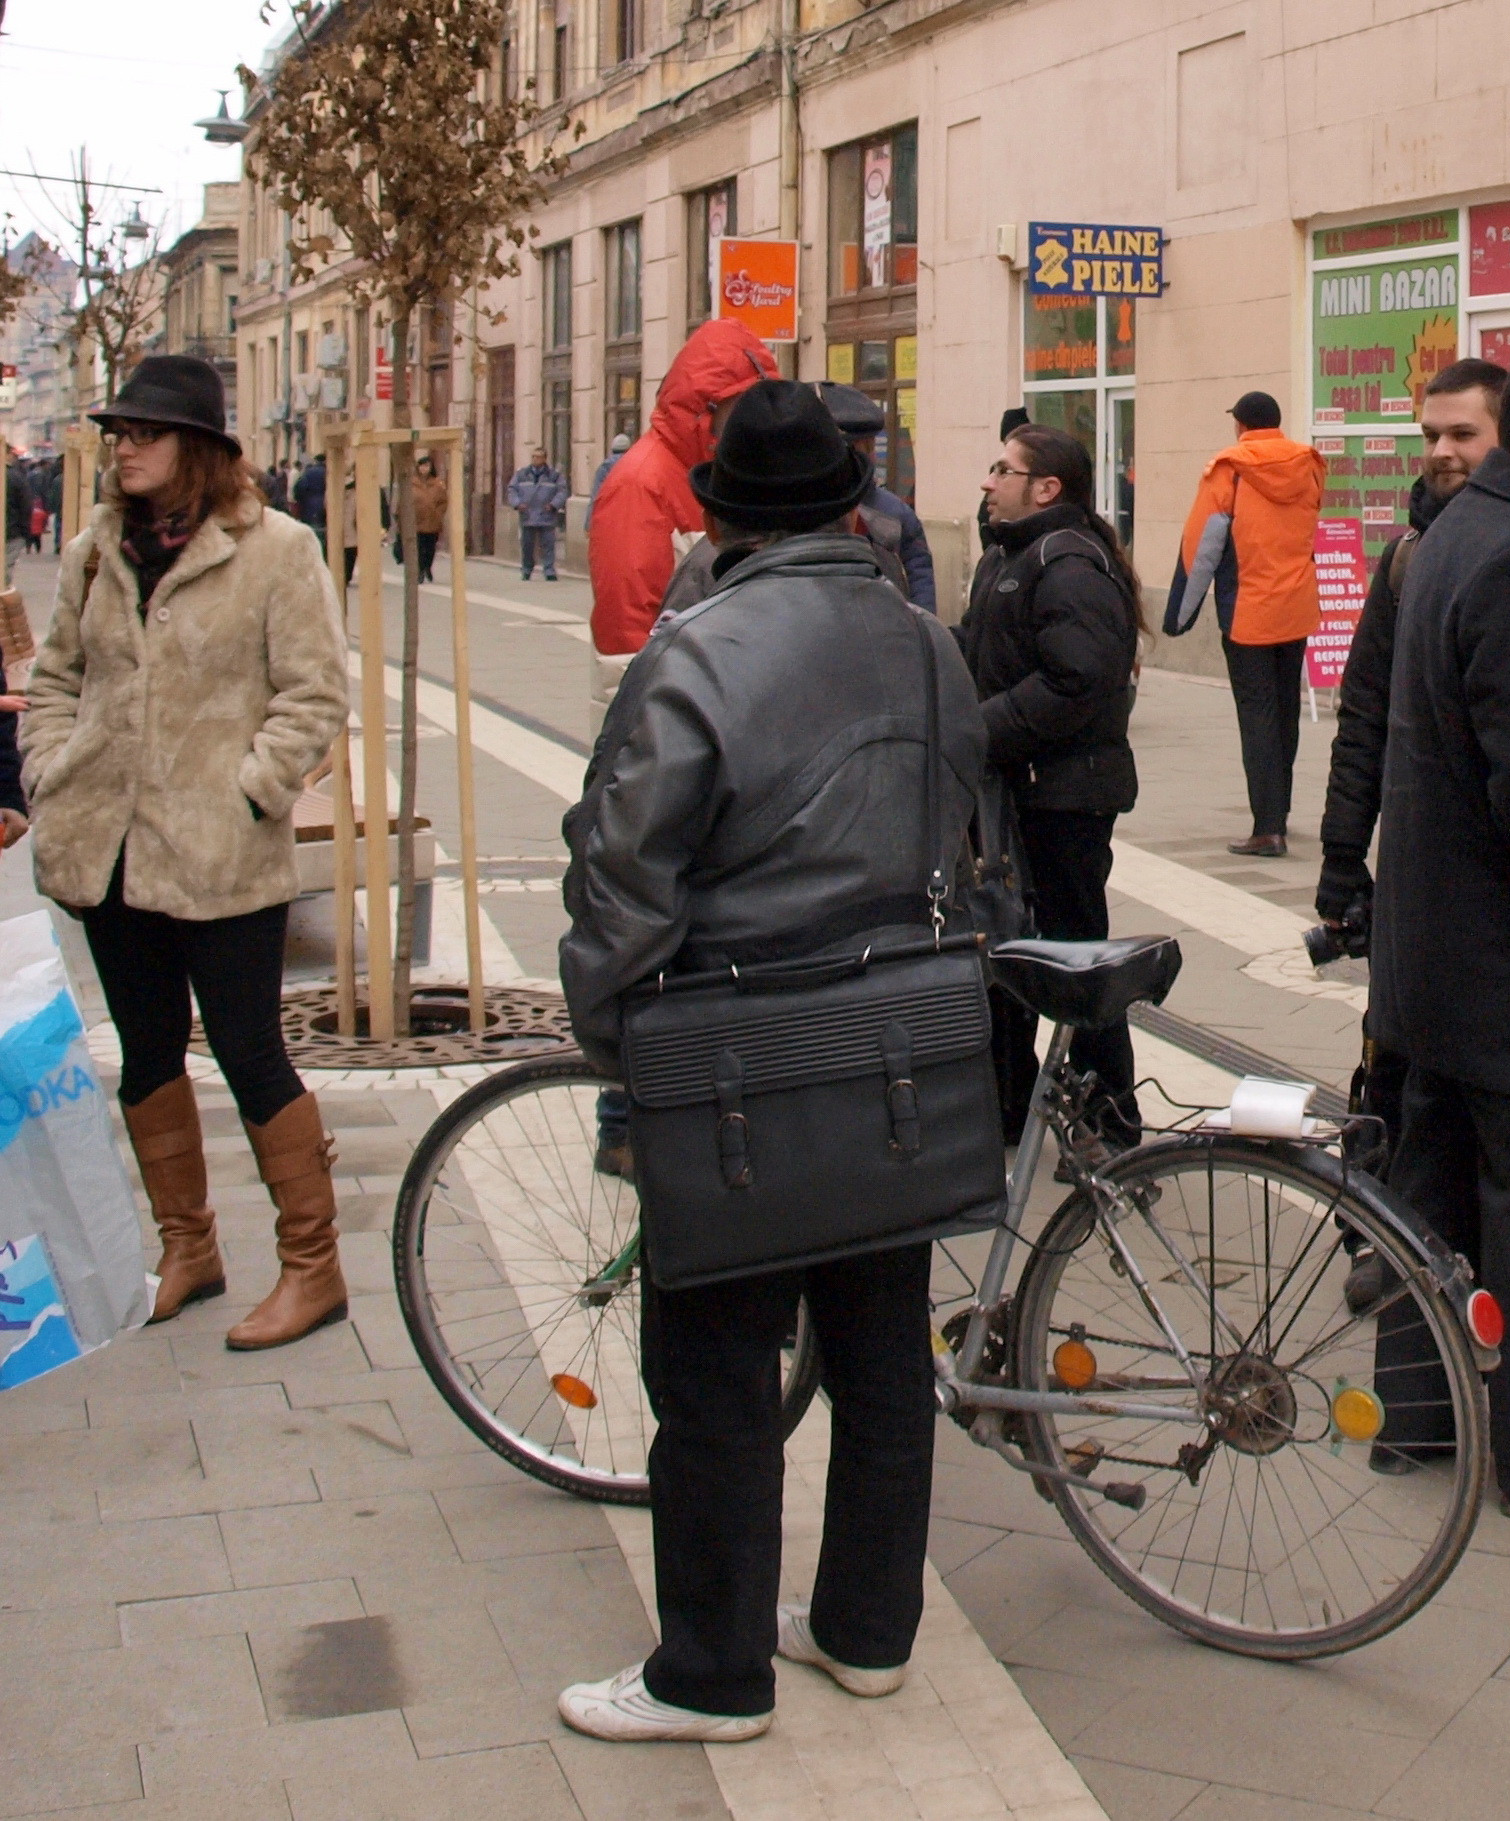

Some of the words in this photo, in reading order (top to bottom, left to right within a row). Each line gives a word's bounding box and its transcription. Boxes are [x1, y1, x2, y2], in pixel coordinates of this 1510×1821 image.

[1071, 228, 1160, 257] HAINE
[1071, 259, 1160, 294] PIELE
[1320, 274, 1372, 317] MINI
[1379, 264, 1457, 312] BAZAR
[1319, 344, 1349, 377] Totul
[1348, 583, 1364, 595] DE
[0, 1064, 95, 1127] ODKA
